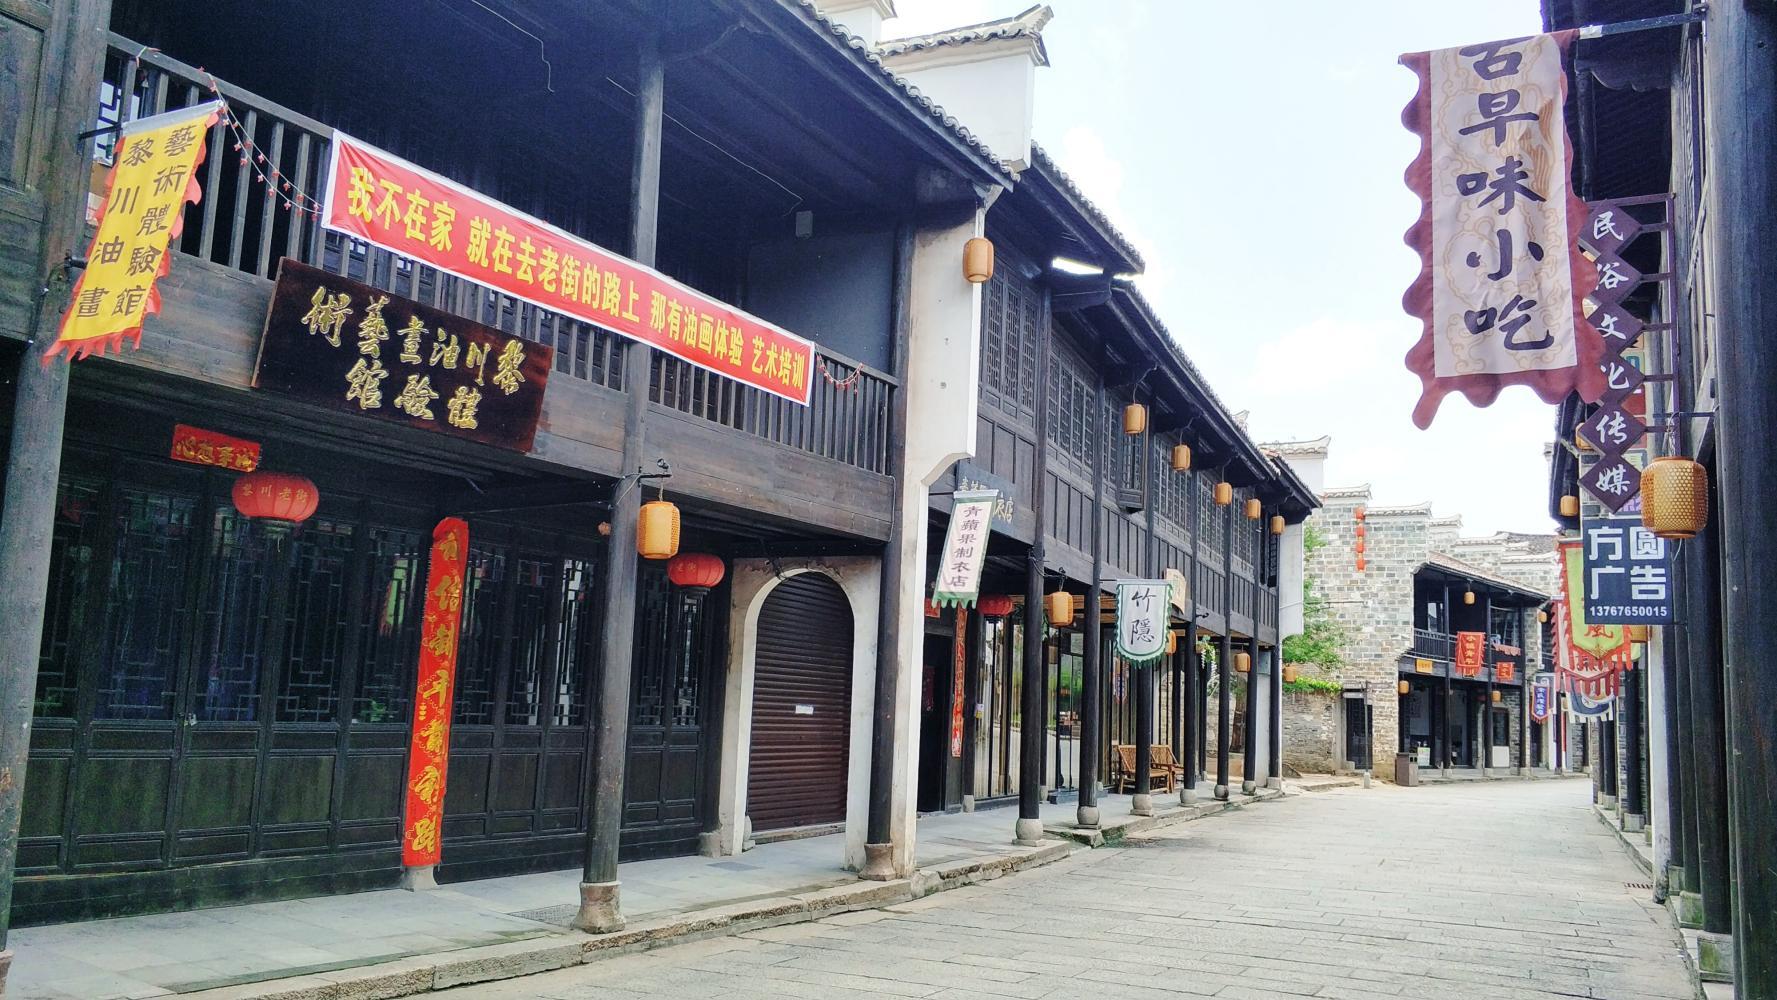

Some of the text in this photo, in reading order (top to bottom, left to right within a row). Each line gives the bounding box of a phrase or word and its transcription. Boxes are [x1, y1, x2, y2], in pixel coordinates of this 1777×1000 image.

[77, 138, 155, 318] 黎川油畫
[111, 124, 198, 316] 藝術體驗館
[1456, 36, 1555, 351] 古早味小吃
[347, 166, 806, 392] 我不在家 就在去老街的路上 那有油画体验 艺术培训
[242, 483, 310, 503] 黎川老街
[1587, 526, 1665, 561] 方圆
[1590, 565, 1667, 600] 广告
[1590, 606, 1668, 617] 13767650015
